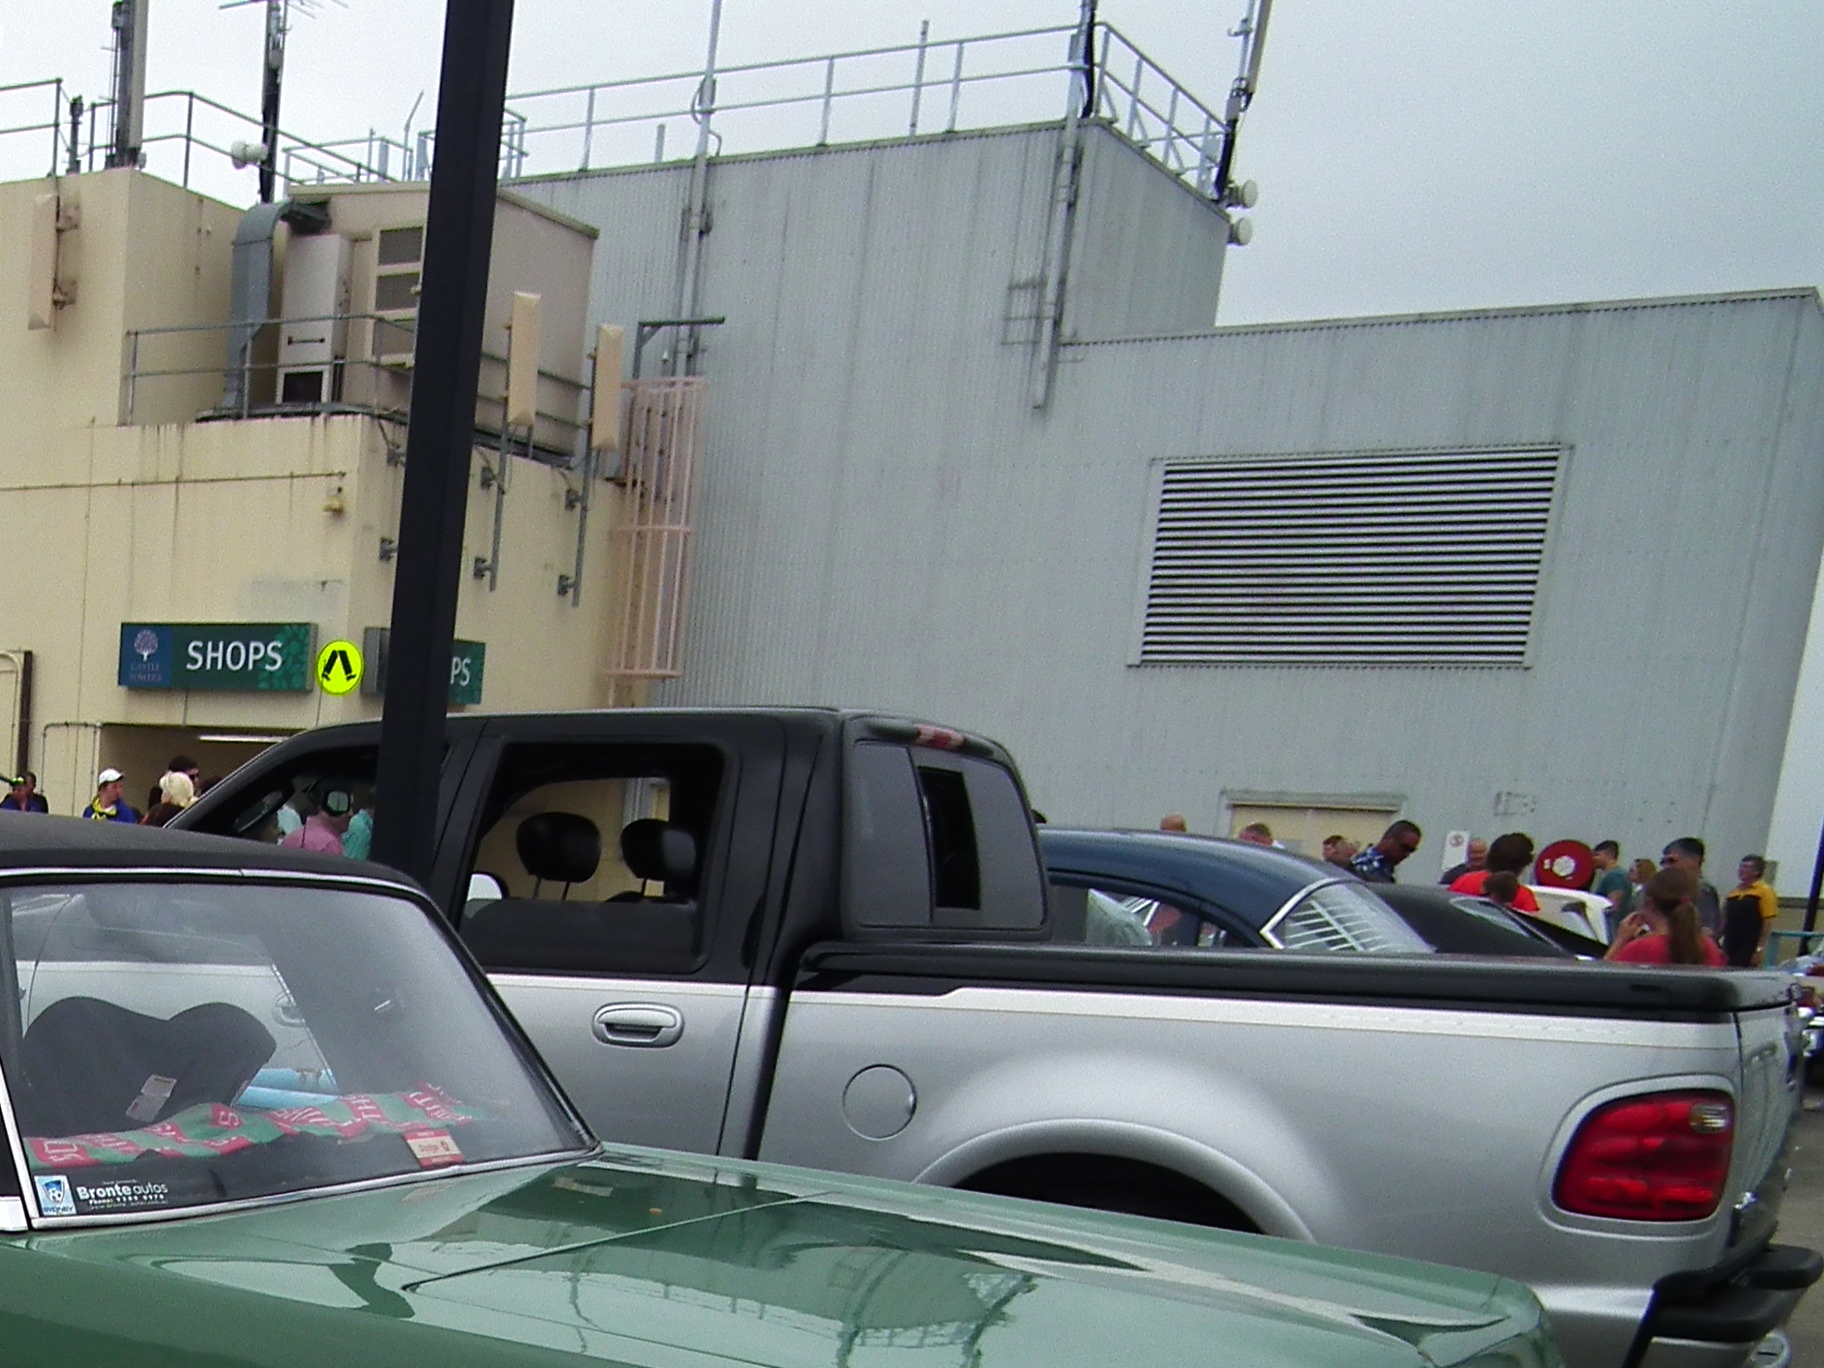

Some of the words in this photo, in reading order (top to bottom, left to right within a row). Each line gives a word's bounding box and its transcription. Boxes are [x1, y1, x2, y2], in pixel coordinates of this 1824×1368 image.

[185, 640, 283, 671] SHOPS
[76, 1183, 132, 1200] Bronte
[132, 1182, 169, 1195] autos
